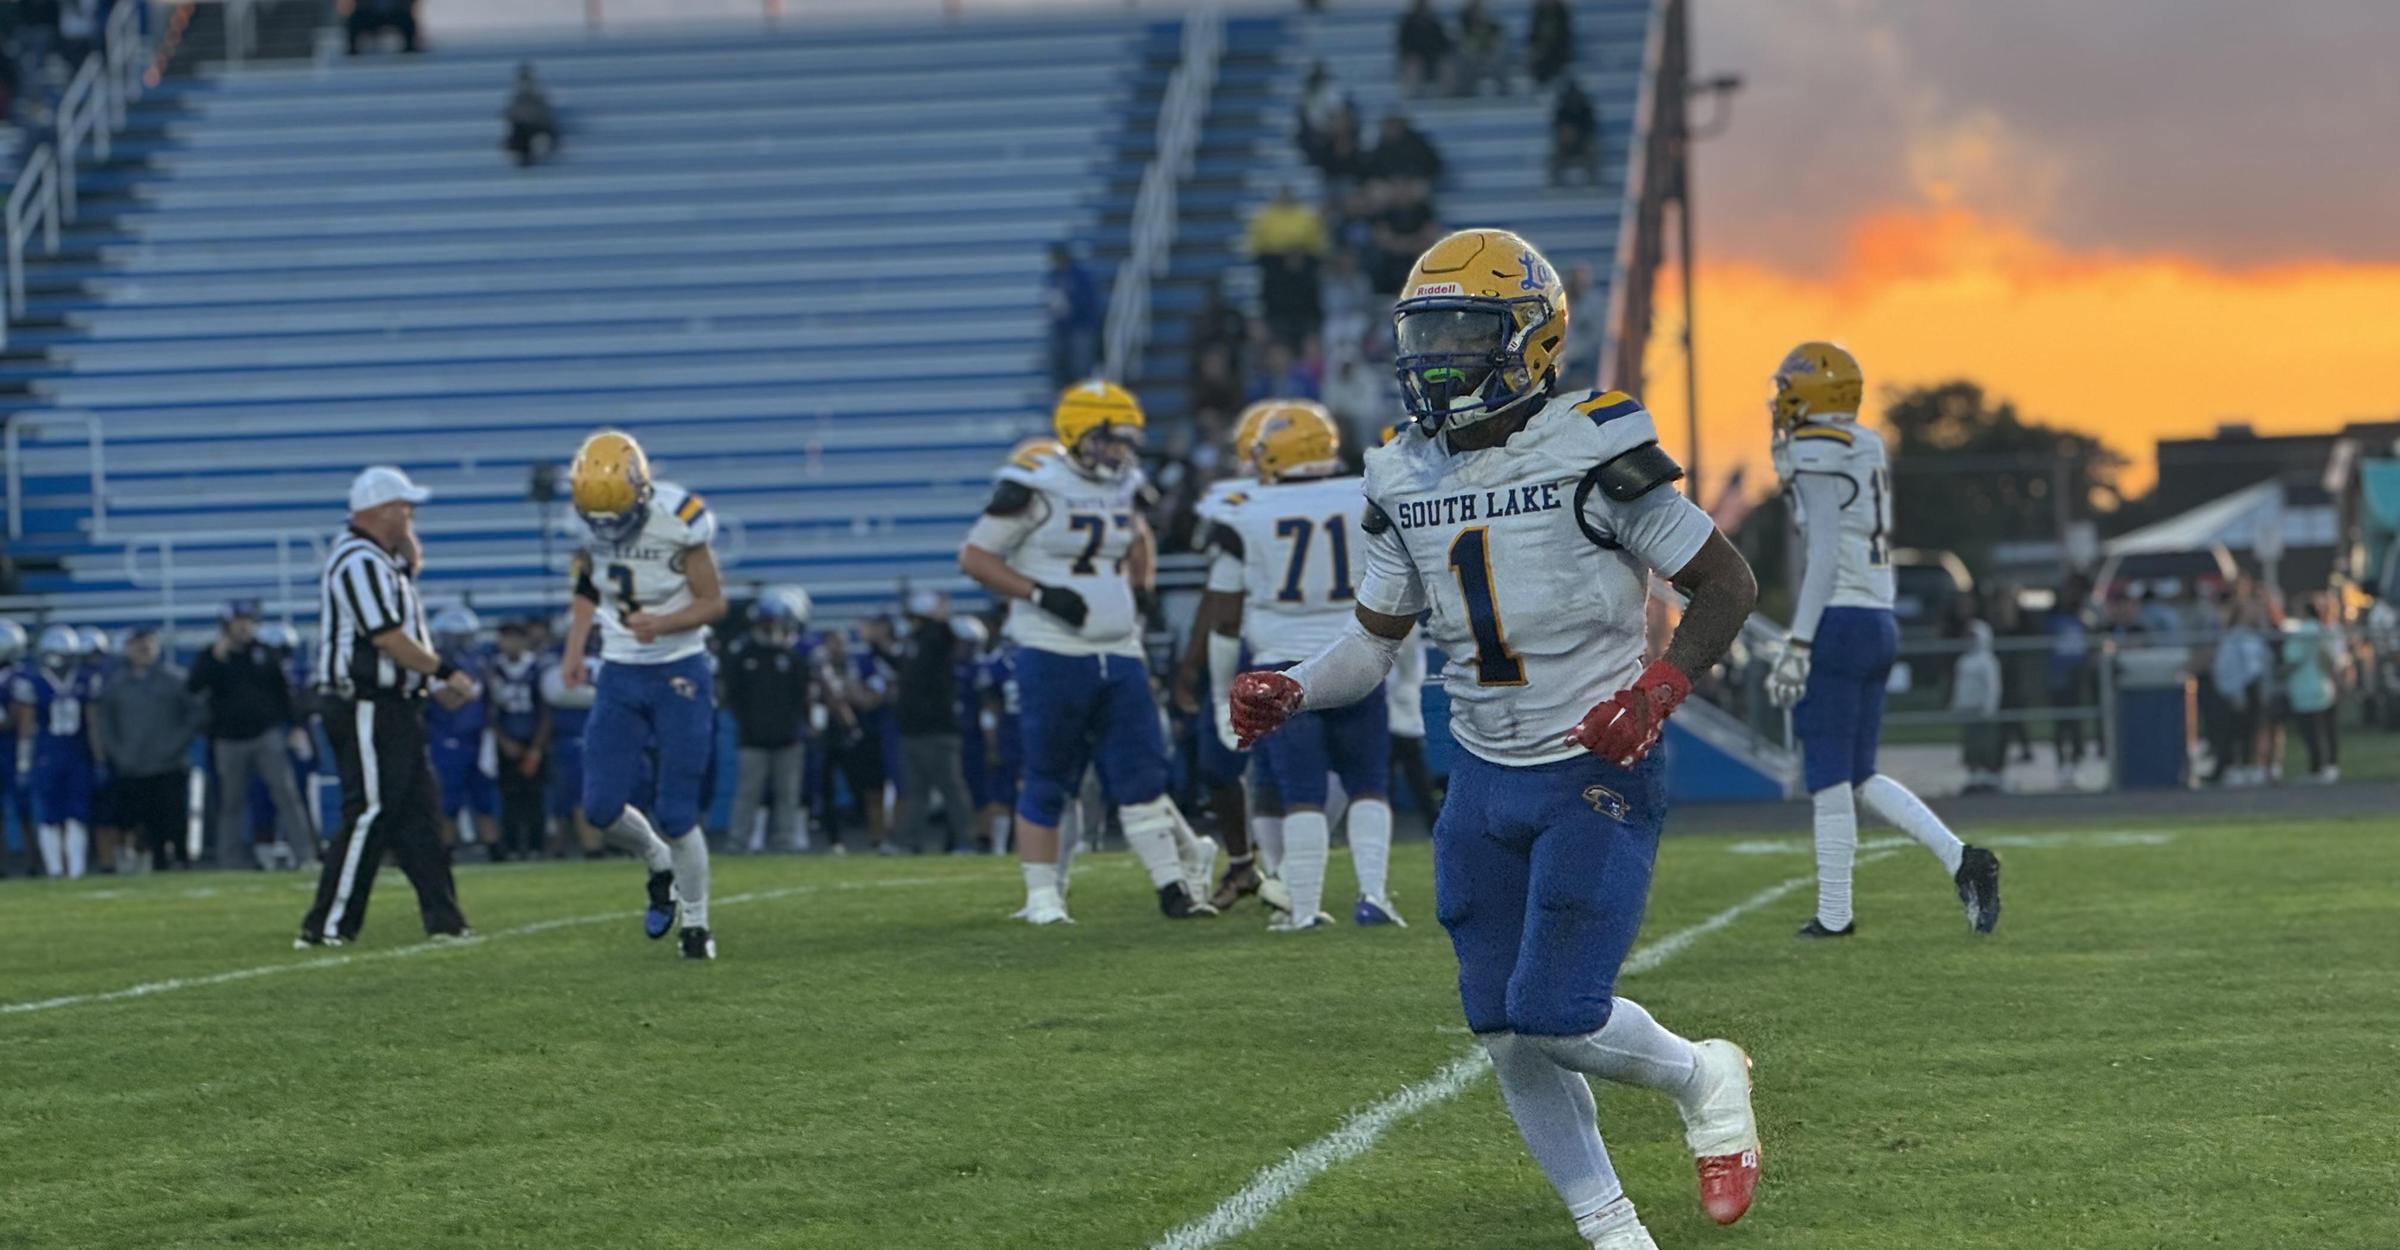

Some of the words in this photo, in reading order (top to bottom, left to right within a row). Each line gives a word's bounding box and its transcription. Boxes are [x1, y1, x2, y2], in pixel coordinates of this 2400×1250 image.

[1416, 284, 1456, 296] Riddell
[1398, 494, 1478, 530] SOUTH
[1486, 482, 1562, 519] LAKE
[1275, 513, 1357, 602] 71
[1448, 524, 1531, 687] 1
